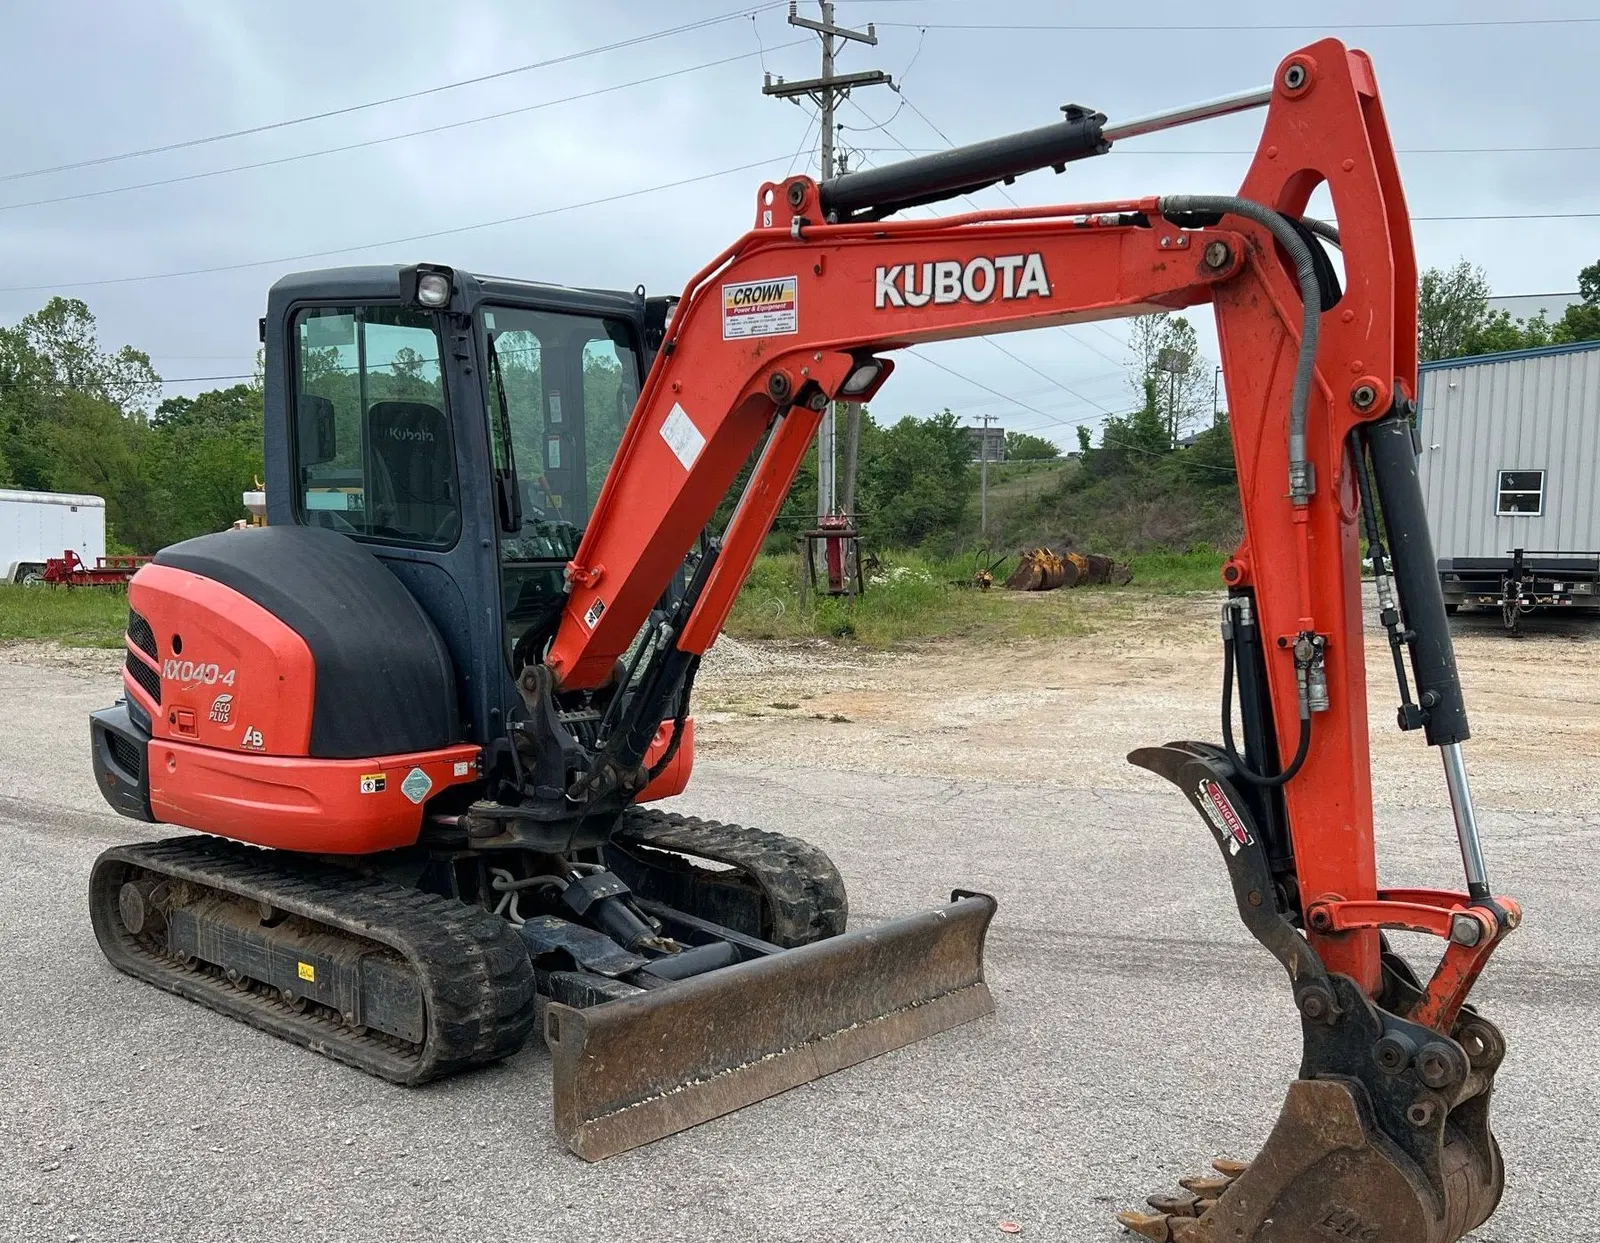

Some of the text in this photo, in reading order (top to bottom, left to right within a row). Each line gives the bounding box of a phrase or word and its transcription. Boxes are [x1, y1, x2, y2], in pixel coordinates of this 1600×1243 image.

[874, 252, 1051, 308] KUBOTA
[733, 283, 785, 306] CROWN
[756, 303, 787, 313] Equipment
[389, 427, 435, 442] Kubota
[162, 659, 236, 687] KX040-4
[208, 711, 229, 723] PLUS
[214, 703, 231, 712] eco
[1212, 793, 1240, 832] DANGER
